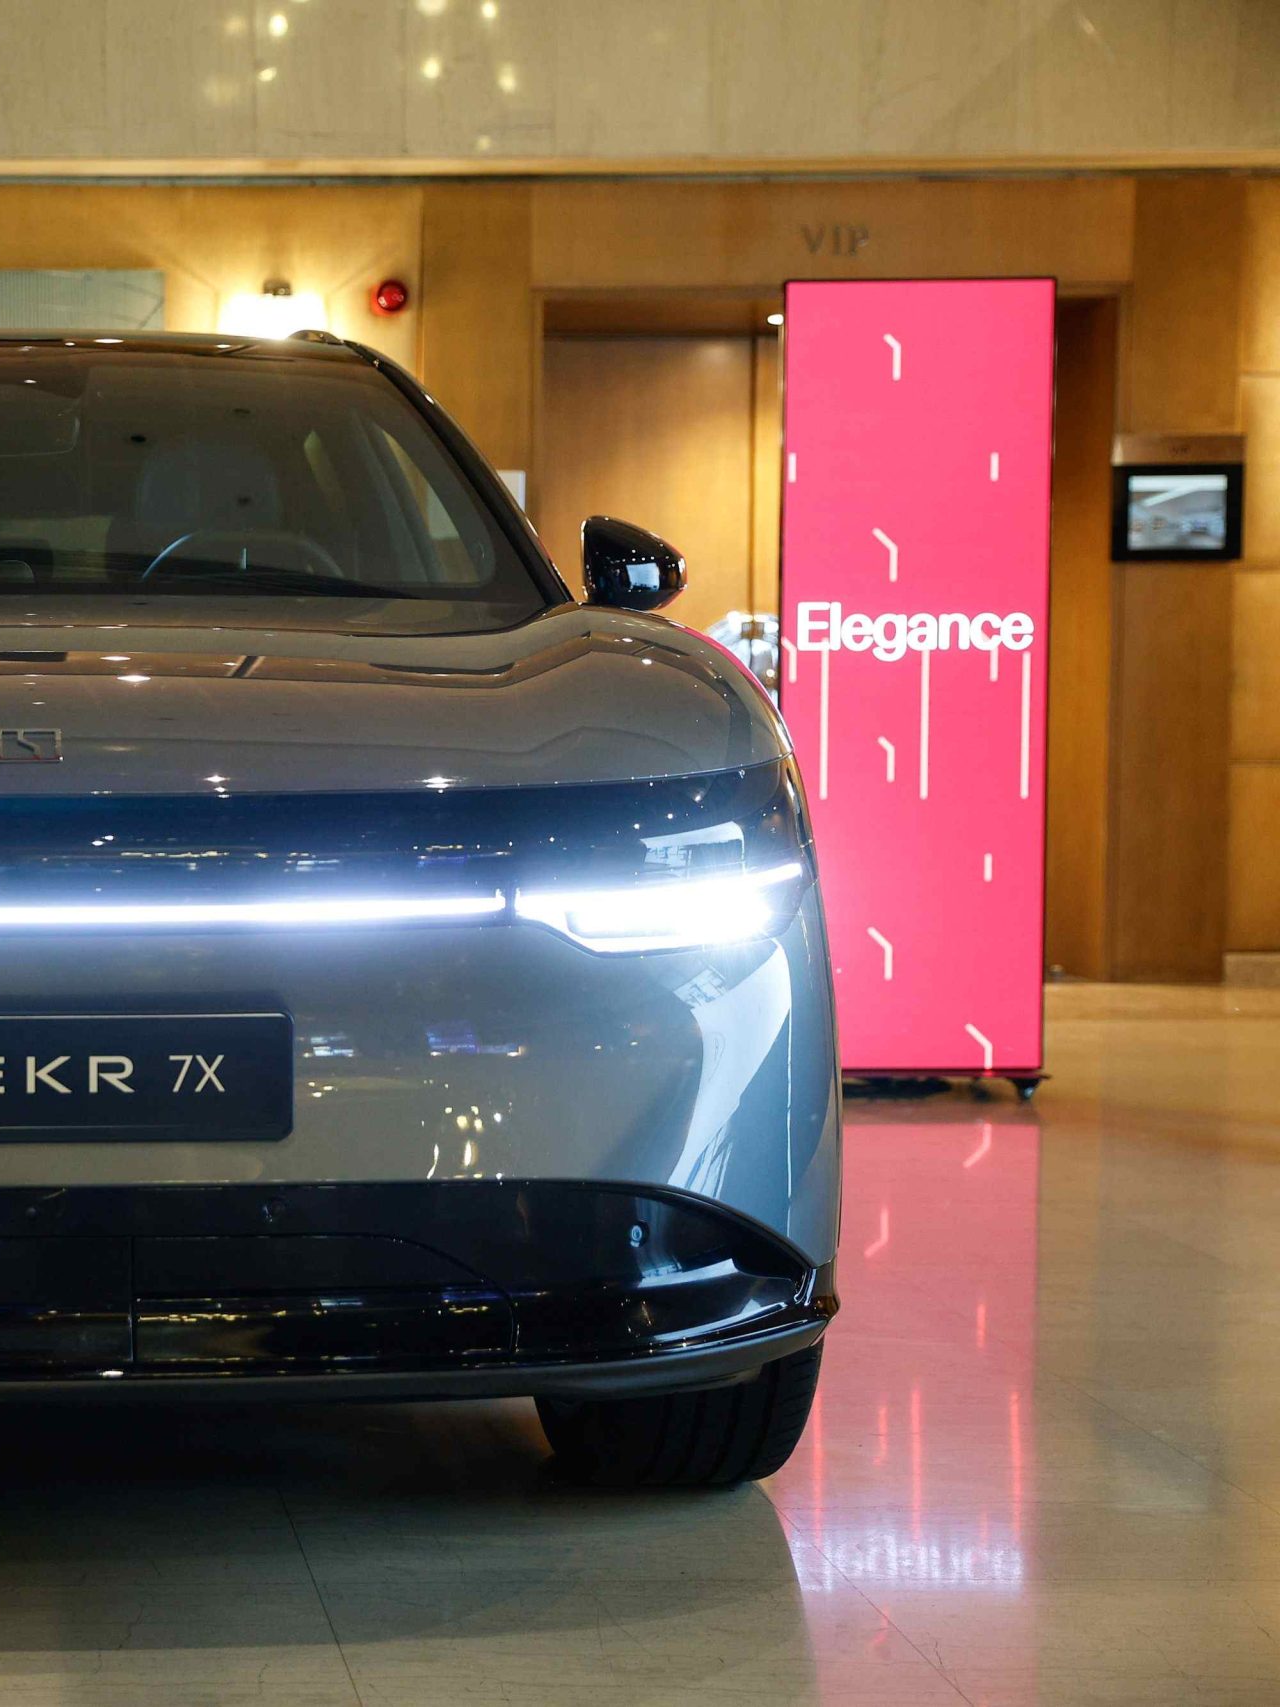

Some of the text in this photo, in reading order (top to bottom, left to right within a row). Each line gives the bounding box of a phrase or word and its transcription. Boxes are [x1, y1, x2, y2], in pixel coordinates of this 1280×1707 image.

[801, 223, 869, 257] VIP
[797, 601, 1035, 662] Elegance
[168, 1053, 226, 1093] 7X
